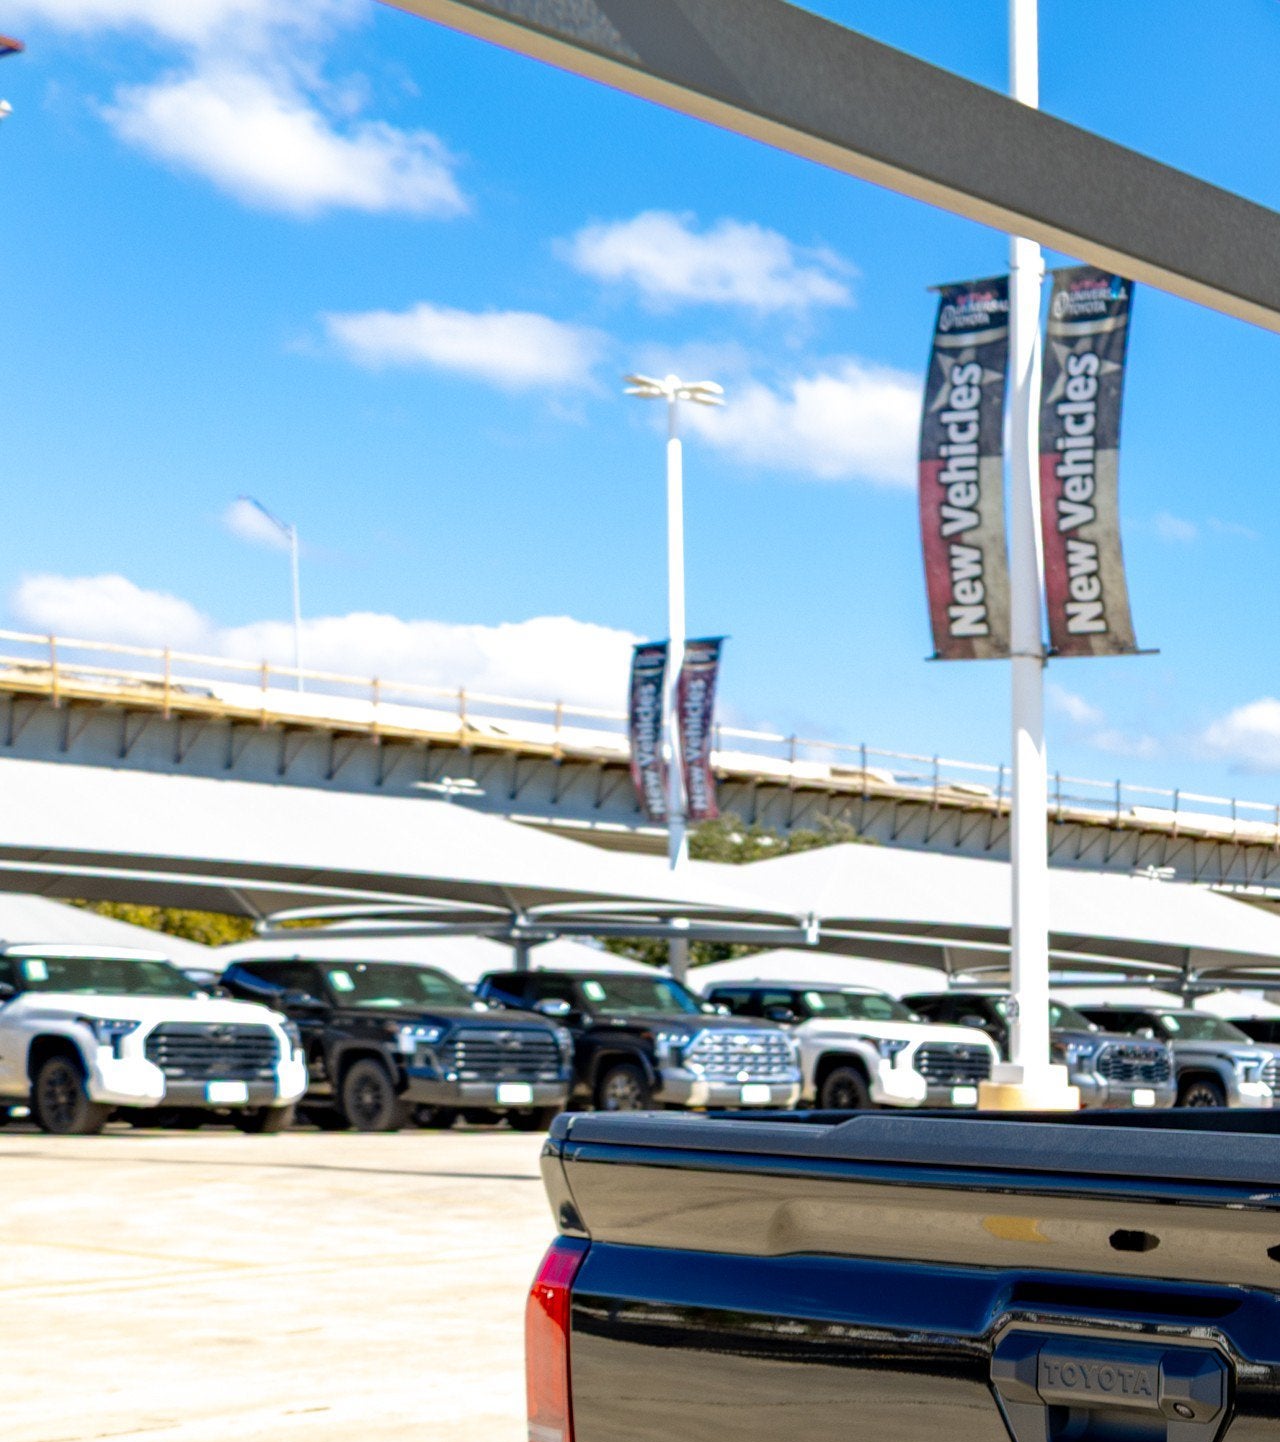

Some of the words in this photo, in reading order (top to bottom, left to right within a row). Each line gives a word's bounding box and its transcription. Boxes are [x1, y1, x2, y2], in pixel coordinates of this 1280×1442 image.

[938, 361, 984, 538] Vehicles
[1055, 351, 1102, 531] Vehicles
[947, 544, 990, 638] New
[1065, 538, 1109, 635] New
[635, 684, 656, 768] Vehicles
[684, 679, 706, 763] Vehicles
[1043, 1360, 1153, 1396] TOYOTA
